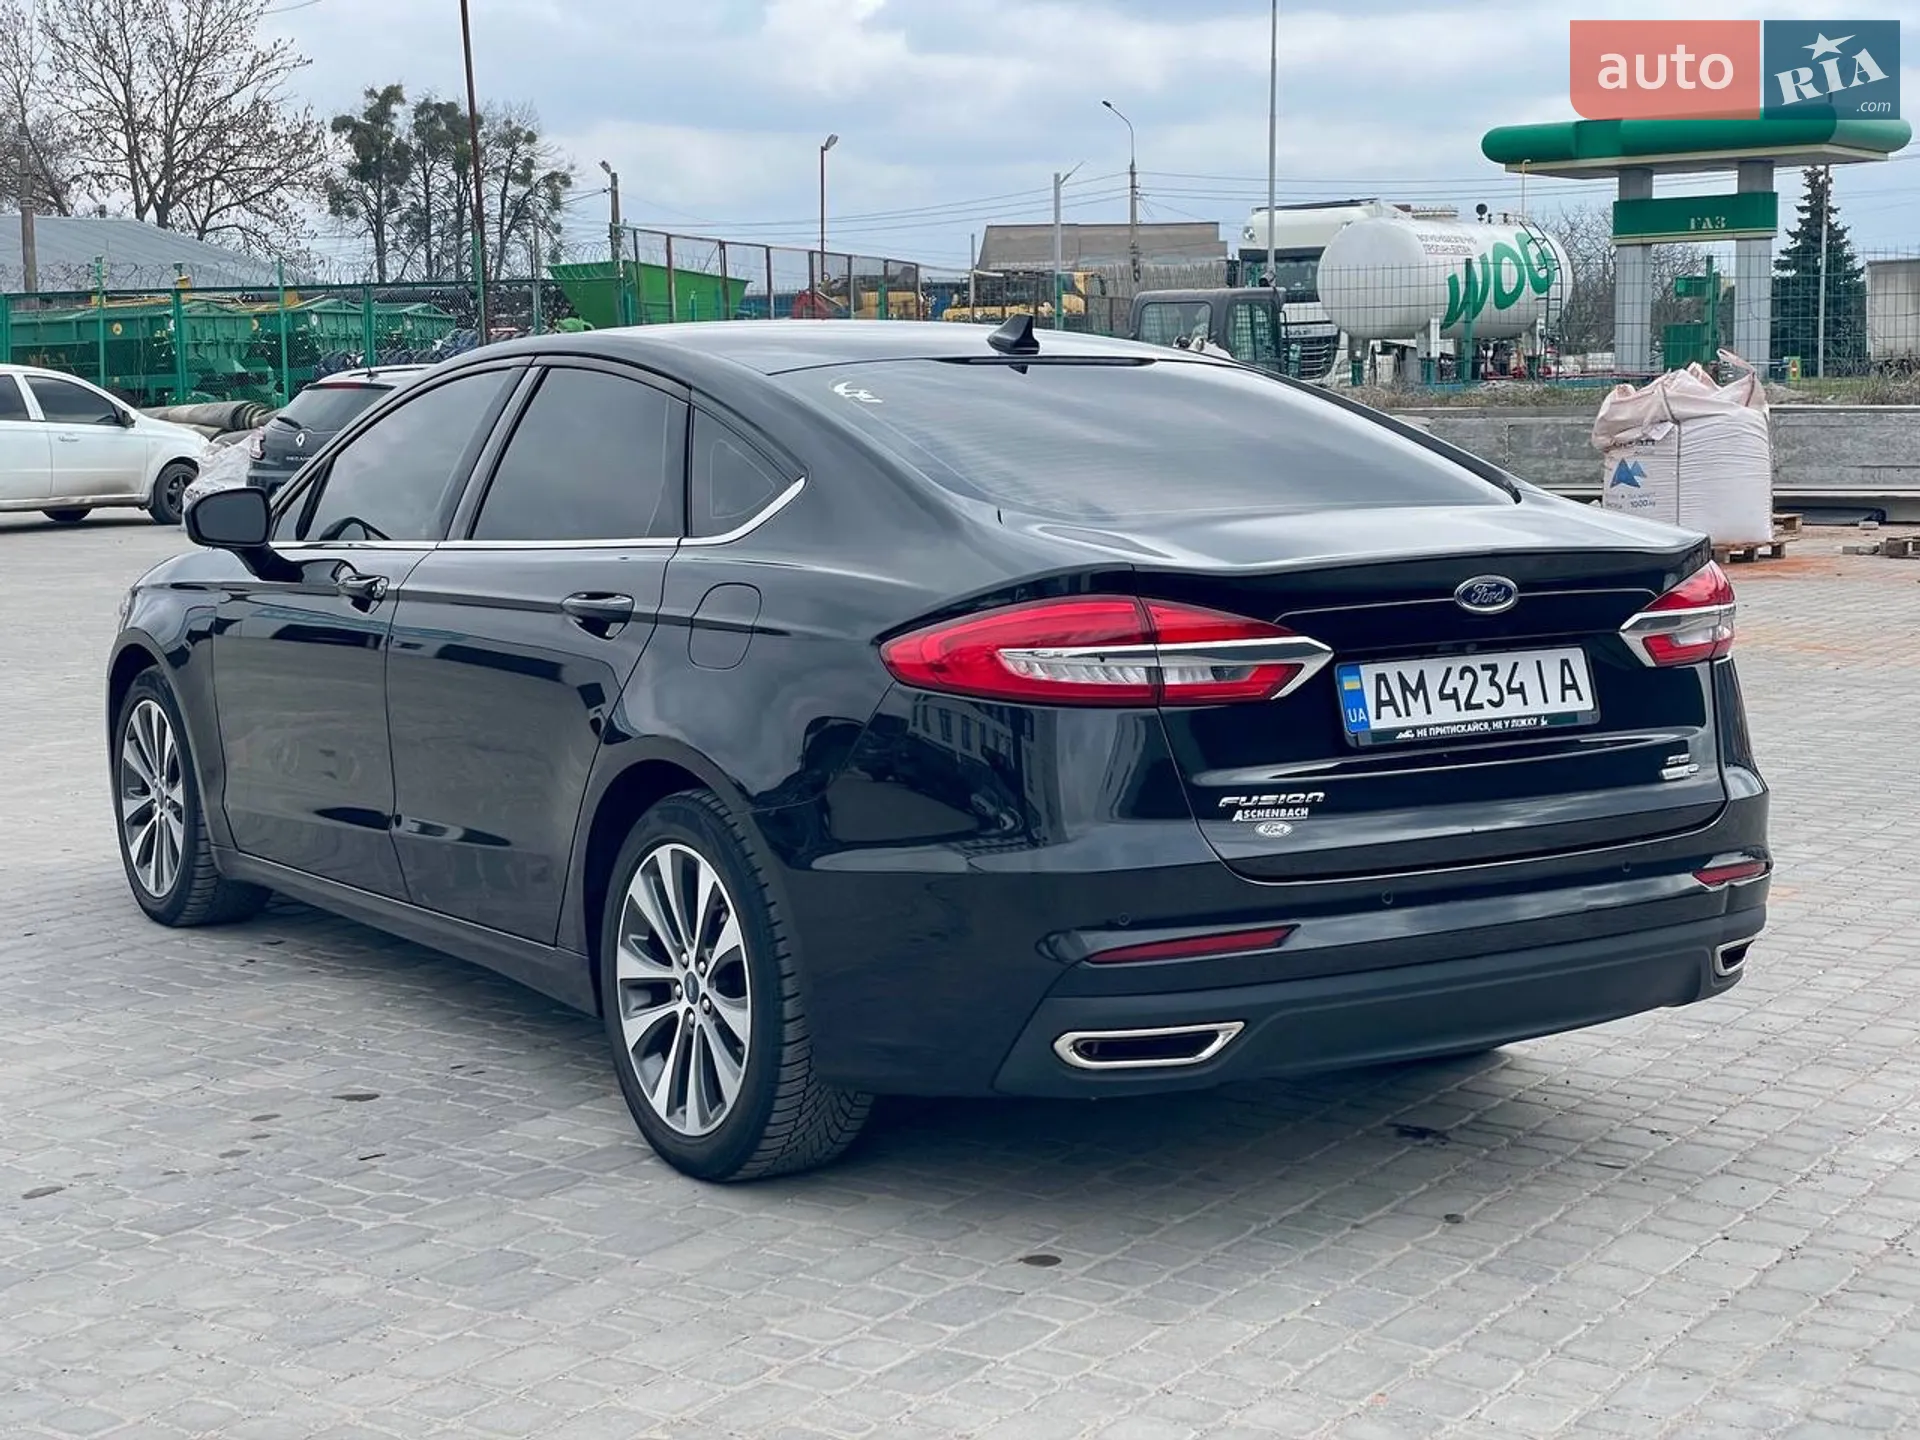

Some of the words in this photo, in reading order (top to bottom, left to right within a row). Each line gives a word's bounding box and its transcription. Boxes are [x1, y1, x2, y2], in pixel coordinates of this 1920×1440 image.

[1690, 215, 1727, 229] ГАЗ
[1440, 232, 1556, 331] WOG
[1471, 583, 1506, 604] Ford
[1375, 669, 1432, 720] AM
[1438, 661, 1529, 712] 4234
[1536, 658, 1584, 704] IA
[1348, 707, 1368, 723] UA
[1416, 727, 1428, 738] НЕ
[1492, 720, 1502, 730] НЕ
[1218, 792, 1326, 808] FUSION
[1232, 807, 1309, 822] ASCHENBACH
